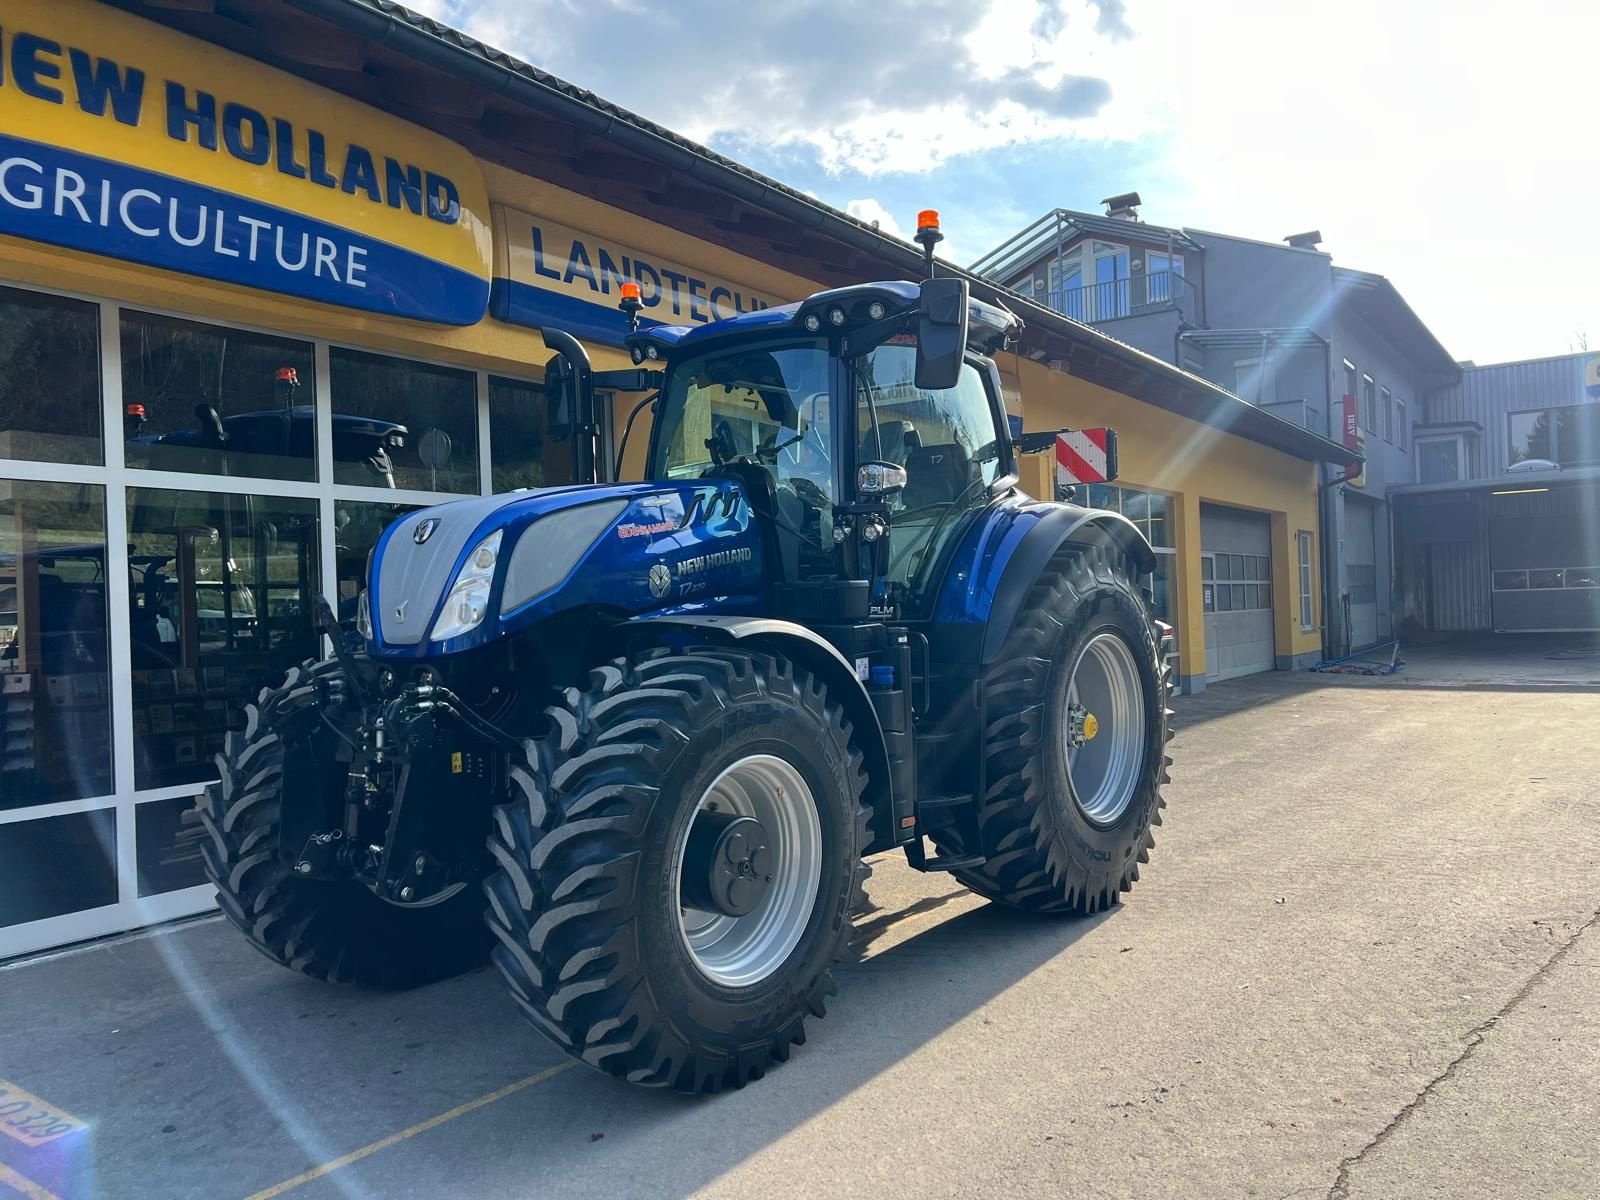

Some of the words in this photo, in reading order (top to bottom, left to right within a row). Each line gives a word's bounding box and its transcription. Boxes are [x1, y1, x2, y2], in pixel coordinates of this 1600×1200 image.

[0, 24, 145, 127] EW
[165, 80, 460, 225] HOLLAND
[677, 556, 704, 577] NEW
[705, 547, 752, 569] HOLLAND
[870, 606, 894, 615] PLM
[0, 1089, 73, 1138] 0329
